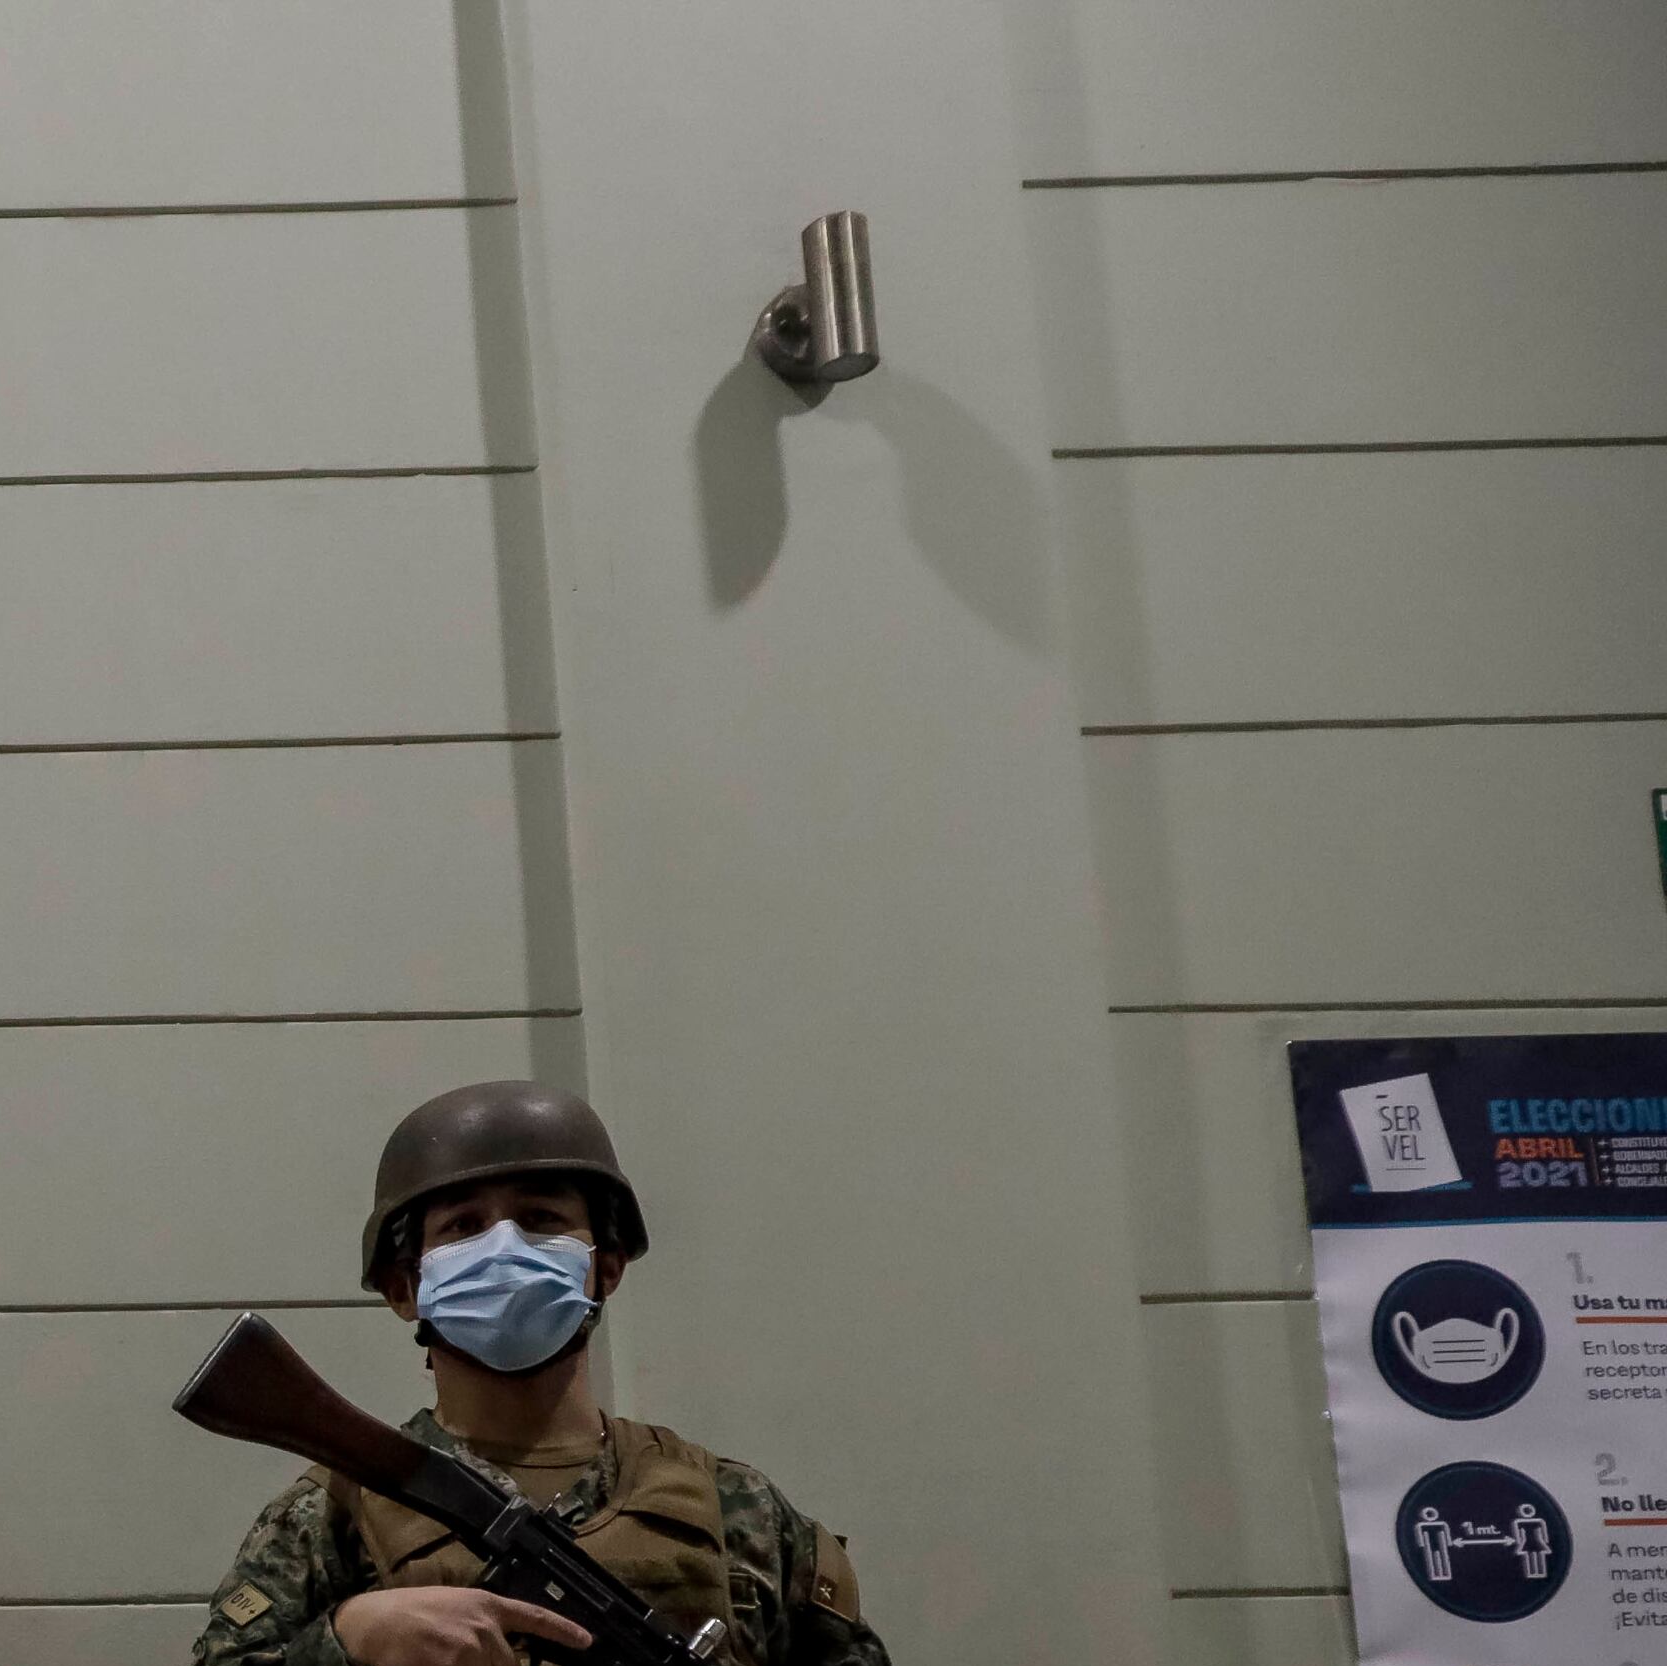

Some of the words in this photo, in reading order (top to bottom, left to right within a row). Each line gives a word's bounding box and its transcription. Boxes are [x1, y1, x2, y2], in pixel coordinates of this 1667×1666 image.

[1378, 1105, 1421, 1132] SER
[1381, 1134, 1426, 1160] VEL
[1495, 1137, 1585, 1160] ABRIL
[1497, 1161, 1588, 1188] 2021
[1567, 1252, 1594, 1284] 1.
[1573, 1294, 1615, 1310] Usa
[1617, 1295, 1641, 1310] tu
[1582, 1340, 1607, 1355] En
[1611, 1337, 1640, 1355] los
[1588, 1387, 1662, 1401] secreta
[1594, 1453, 1629, 1485] 2.
[1601, 1496, 1634, 1512] No
[1639, 1494, 1667, 1511] lle
[1608, 1543, 1623, 1558] A
[1611, 1567, 1667, 1581] mant
[1612, 1588, 1638, 1604] de
